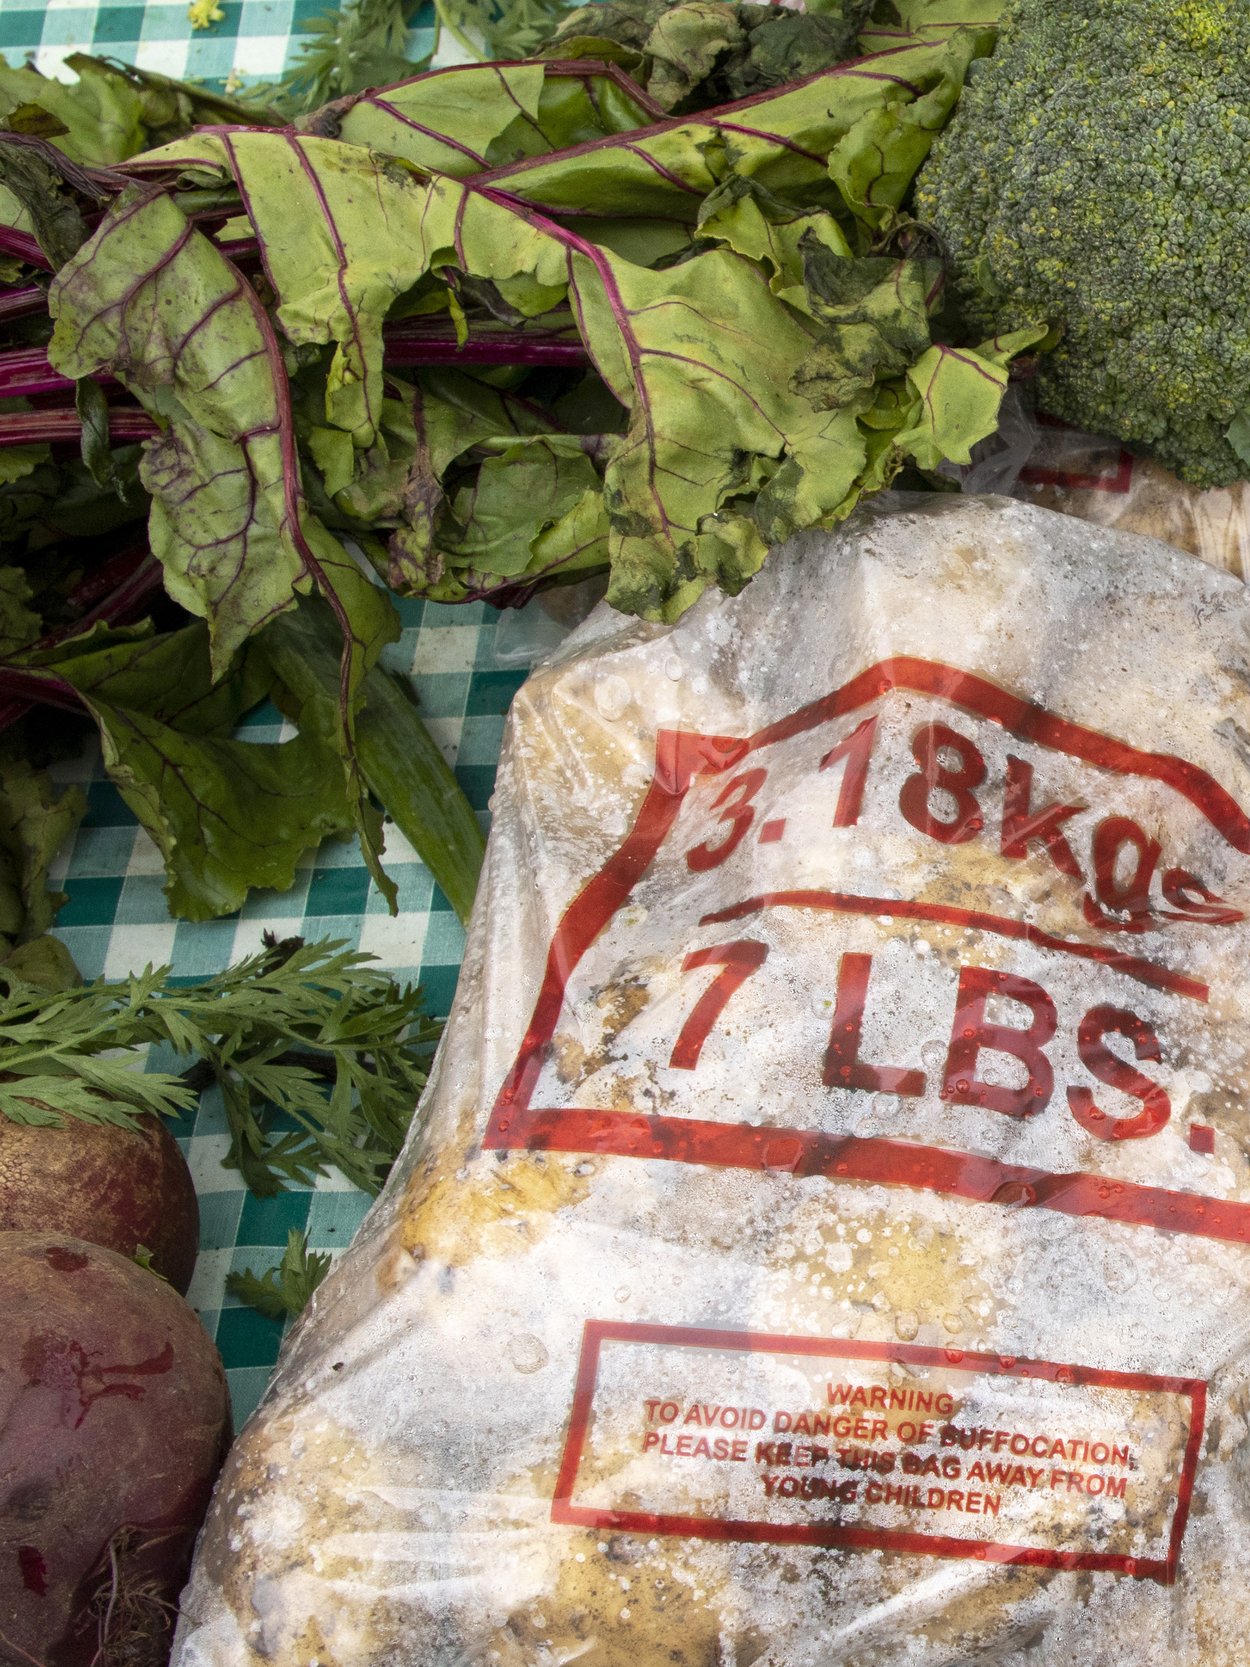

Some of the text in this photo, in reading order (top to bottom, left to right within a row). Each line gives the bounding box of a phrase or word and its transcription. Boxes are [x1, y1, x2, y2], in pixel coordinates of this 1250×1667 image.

[669, 940, 1216, 1155] 7 LBS.
[827, 1382, 954, 1415] WARNING
[642, 1431, 1128, 1500] PLEASE KEEP THIS BAG AWAY FROM
[644, 1399, 1136, 1471] TO AVOID DANGER OF SUFFOCATION,
[760, 1474, 1001, 1517] YOUNG CHILDREN
